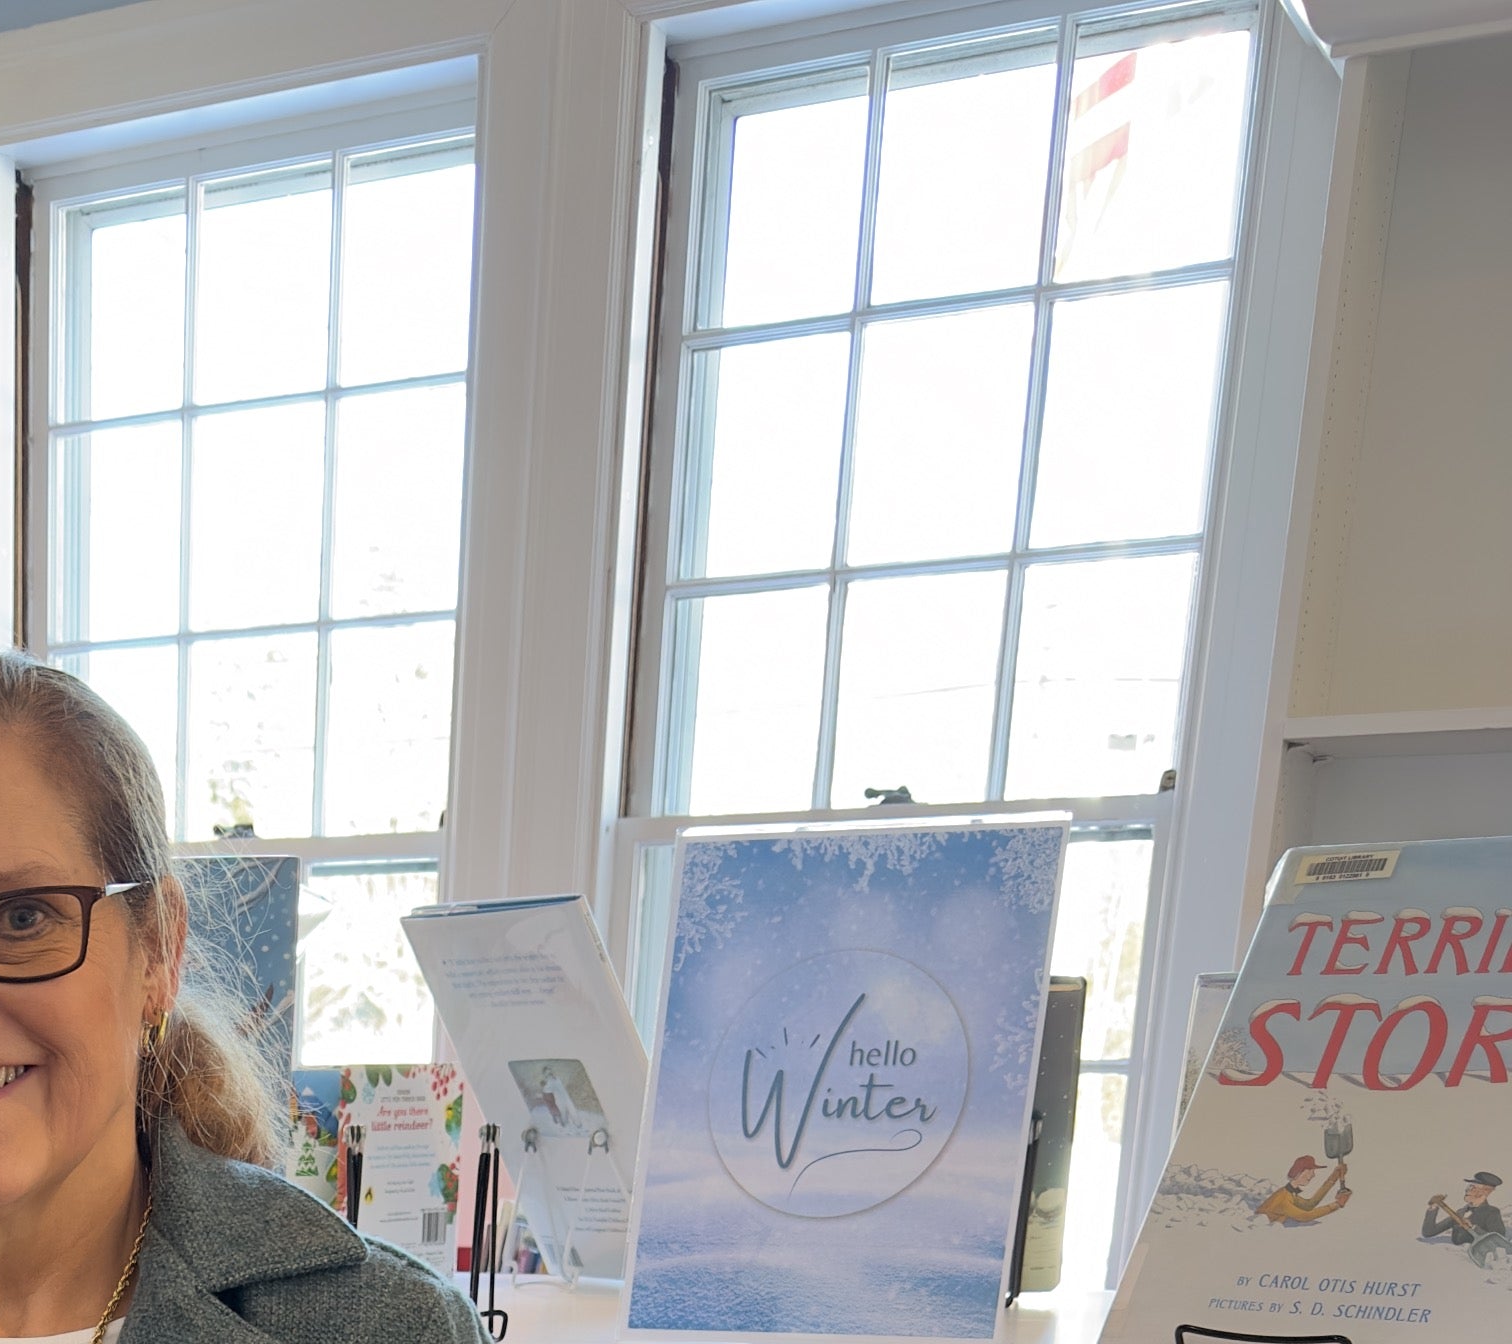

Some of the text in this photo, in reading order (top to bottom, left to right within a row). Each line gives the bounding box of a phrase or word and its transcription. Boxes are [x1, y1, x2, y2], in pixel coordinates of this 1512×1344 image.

[849, 1040, 917, 1068] hello
[741, 992, 937, 1170] Winter
[377, 1106, 429, 1118] Are you there
[371, 1119, 434, 1132] little reindeer?
[1236, 1274, 1422, 1298] BY CAROL OTIS HURST
[1207, 1297, 1432, 1324] PICTURES BY S. D. SCHINDLER
